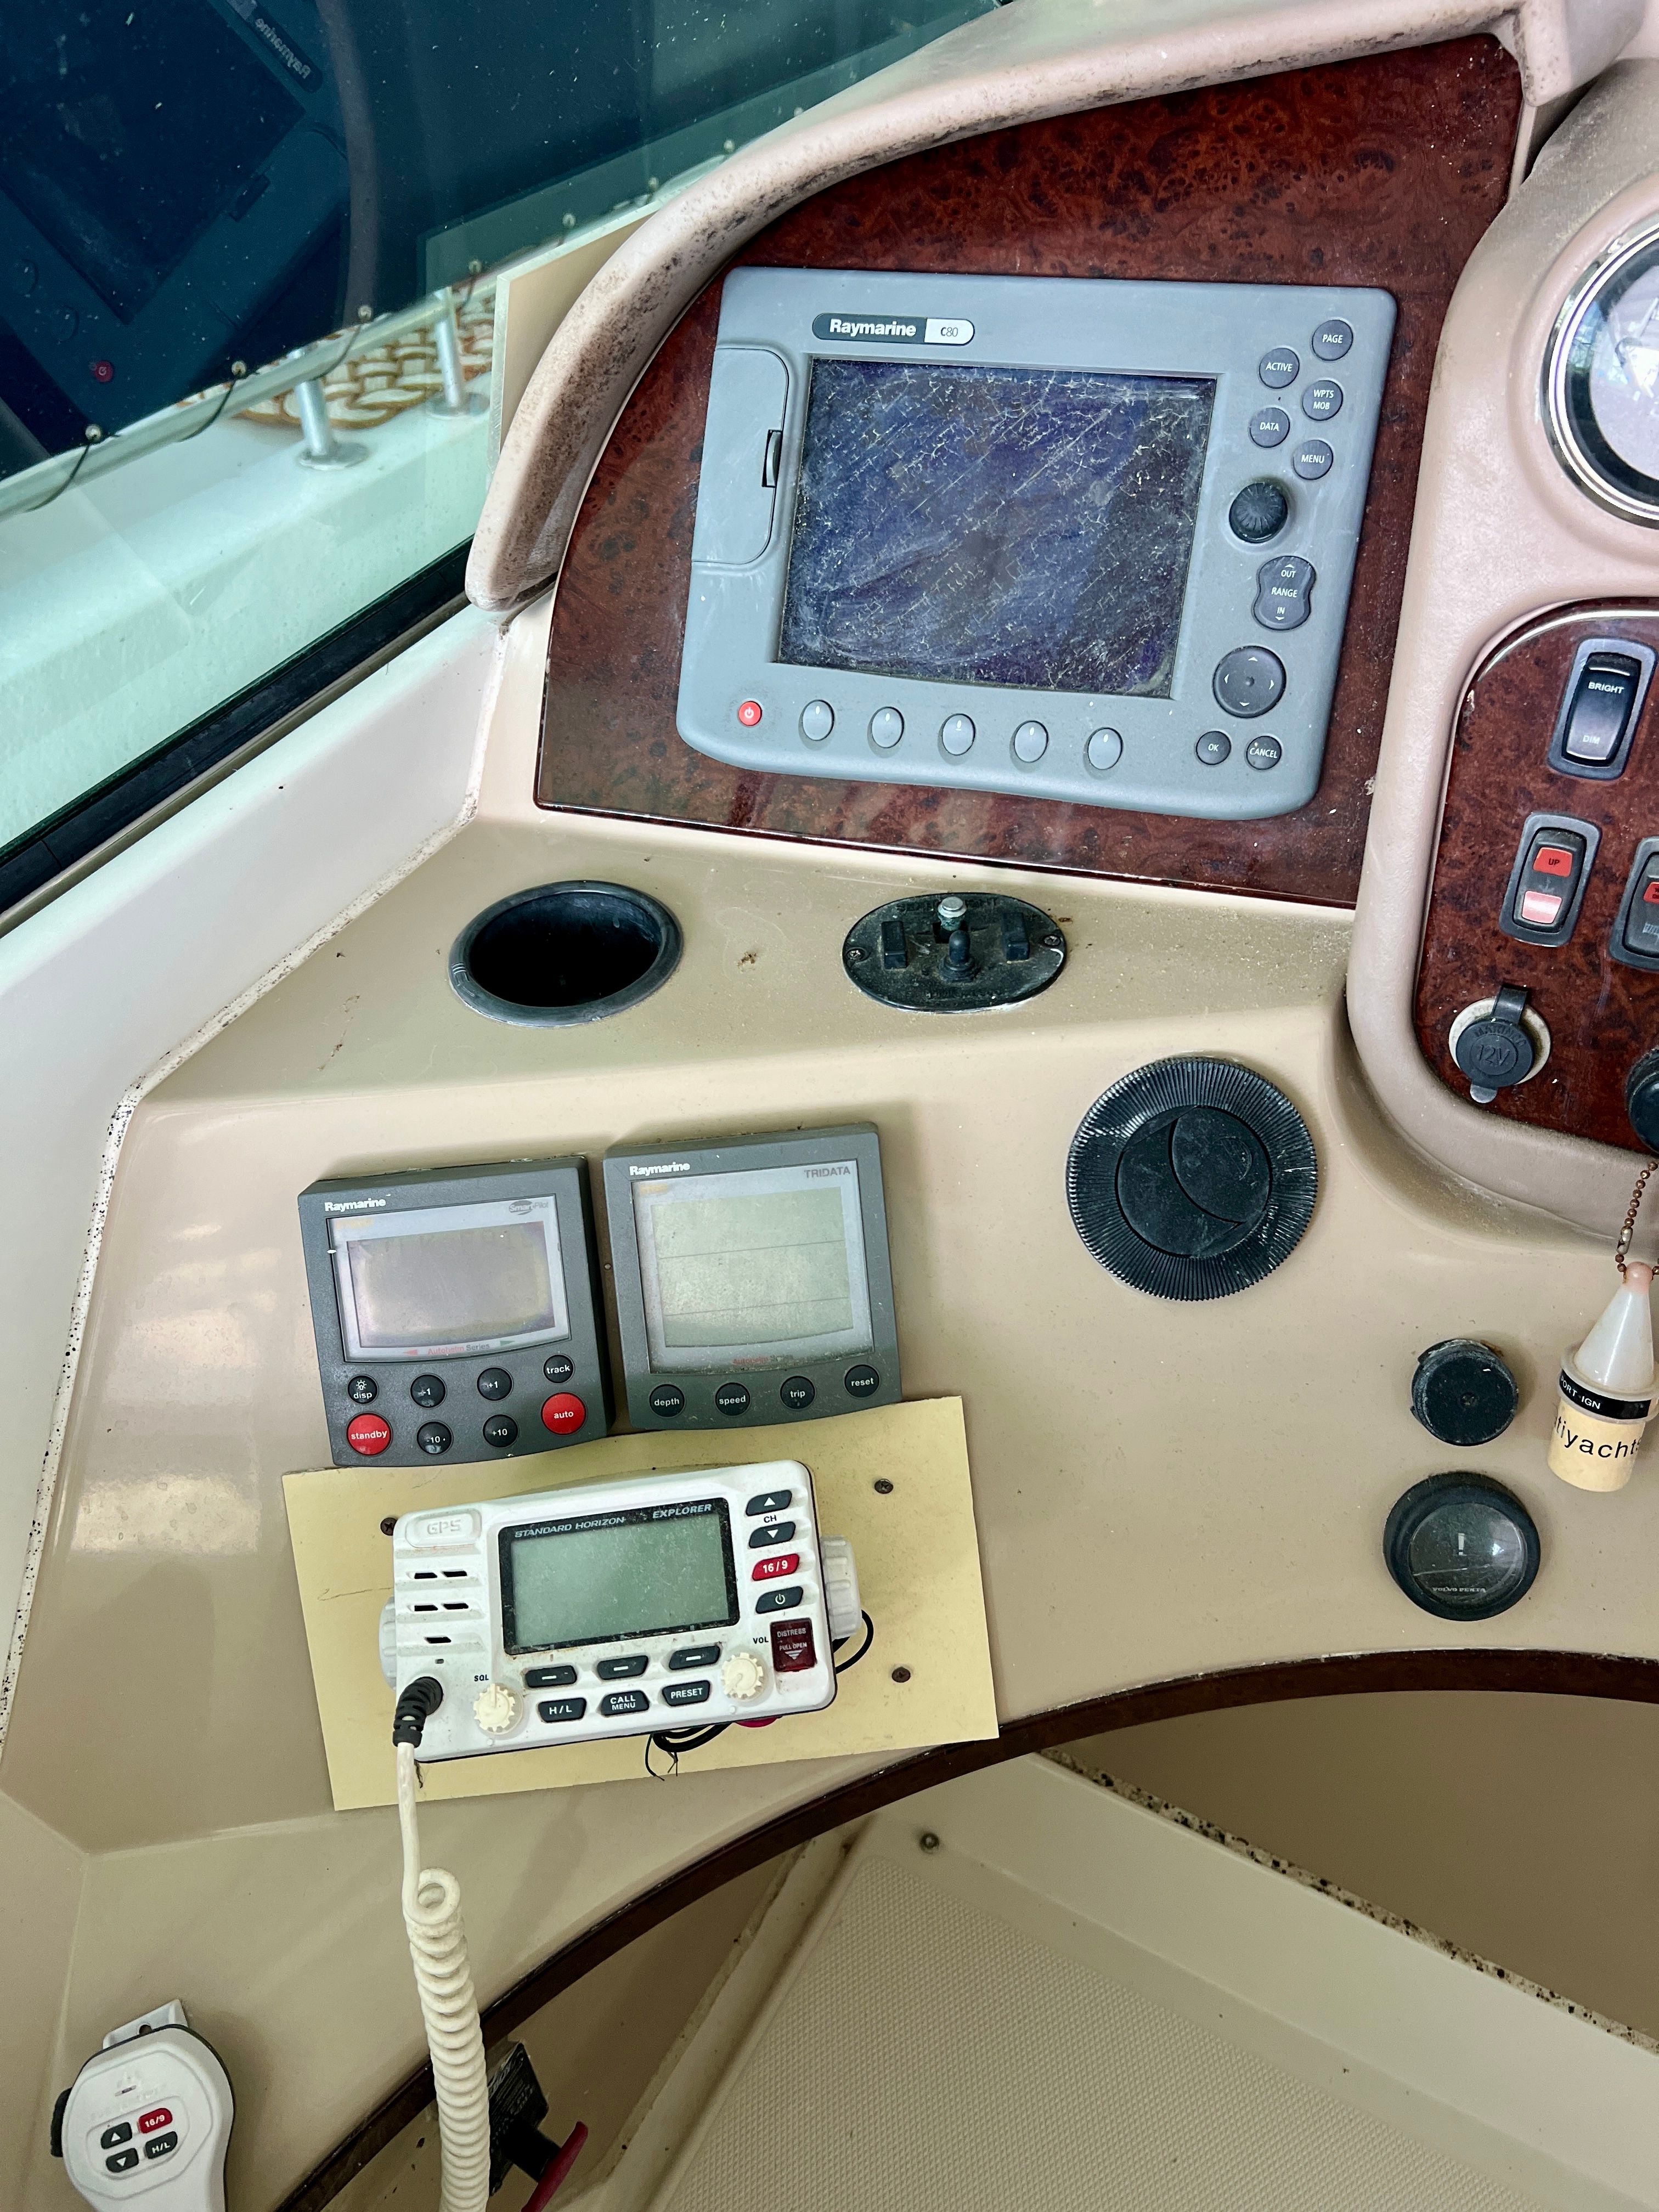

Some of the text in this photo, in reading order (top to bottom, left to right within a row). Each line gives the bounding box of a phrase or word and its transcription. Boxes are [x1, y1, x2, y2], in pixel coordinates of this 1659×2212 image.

[830, 318, 958, 337] Raymarine C80
[1322, 334, 1343, 343] PAGE
[1265, 362, 1293, 372] ACTIVE
[1313, 389, 1334, 398] WPTS
[1313, 401, 1330, 410] MOB
[1259, 421, 1280, 431] DATA
[1301, 454, 1325, 464] MENU
[1281, 569, 1296, 579] OUT
[1271, 586, 1297, 598] RANGE
[1588, 681, 1624, 695] BRIGHT
[1582, 735, 1601, 745] DIM
[1207, 743, 1219, 752] OK
[1249, 747, 1278, 759] CANCEL
[1477, 1044, 1510, 1067] 12V
[629, 1161, 690, 1176] Raymarine
[804, 1166, 851, 1179] TRIDATA
[324, 1198, 386, 1212] Raymarine
[546, 1364, 571, 1374] track
[489, 1380, 499, 1389] +1
[851, 1378, 874, 1387] reset
[353, 1390, 373, 1400] disp
[789, 1390, 806, 1399] trip
[654, 1396, 680, 1408] depth
[719, 1394, 747, 1407] speed
[1581, 1396, 1601, 1410] IGN
[553, 1409, 574, 1419] auto
[351, 1429, 388, 1441] standby
[492, 1428, 508, 1437] +10
[652, 1503, 713, 1519] EXPLORER
[763, 1514, 777, 1523] CH
[427, 1519, 461, 1535] GPS
[515, 1516, 626, 1538] STANDARD HORIZON
[777, 1627, 806, 1638] DISTRESS
[753, 1636, 769, 1645] VOL
[779, 1643, 792, 1651] PULL
[473, 1674, 489, 1682] SQL
[670, 1688, 703, 1699] PRESET
[610, 1695, 636, 1705] CALL
[611, 1702, 636, 1711] MENU
[144, 2114, 165, 2128] 16/9
[151, 2141, 171, 2154] H/L
